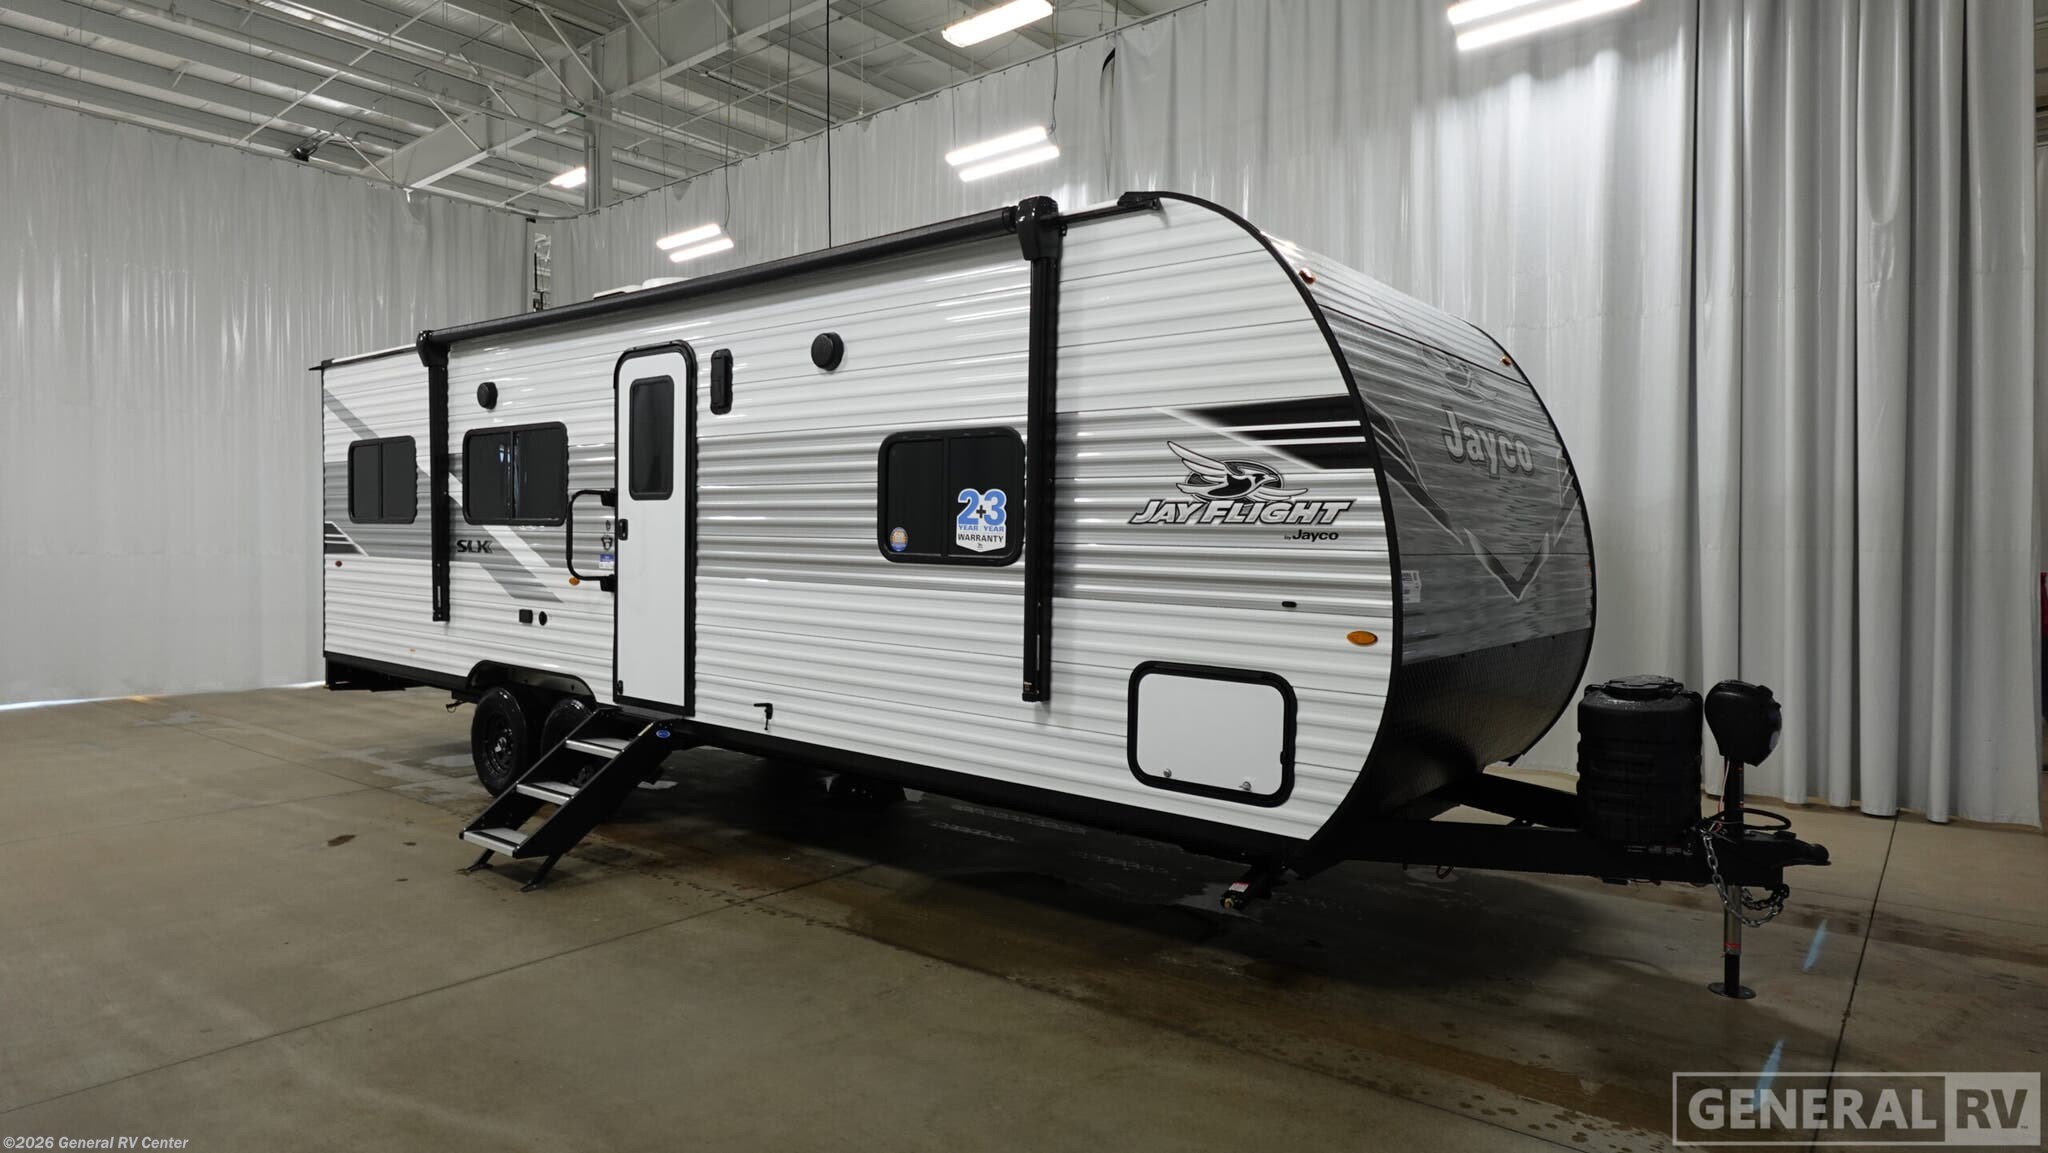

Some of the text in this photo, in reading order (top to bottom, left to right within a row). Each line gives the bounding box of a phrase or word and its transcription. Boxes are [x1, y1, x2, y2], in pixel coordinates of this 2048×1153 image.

[1441, 404, 1534, 478] Jayco
[1129, 499, 1356, 524] JAY FLIGHT
[958, 533, 1004, 543] WARRANTY
[1292, 529, 1339, 542] Jayco
[456, 539, 493, 553] SLK
